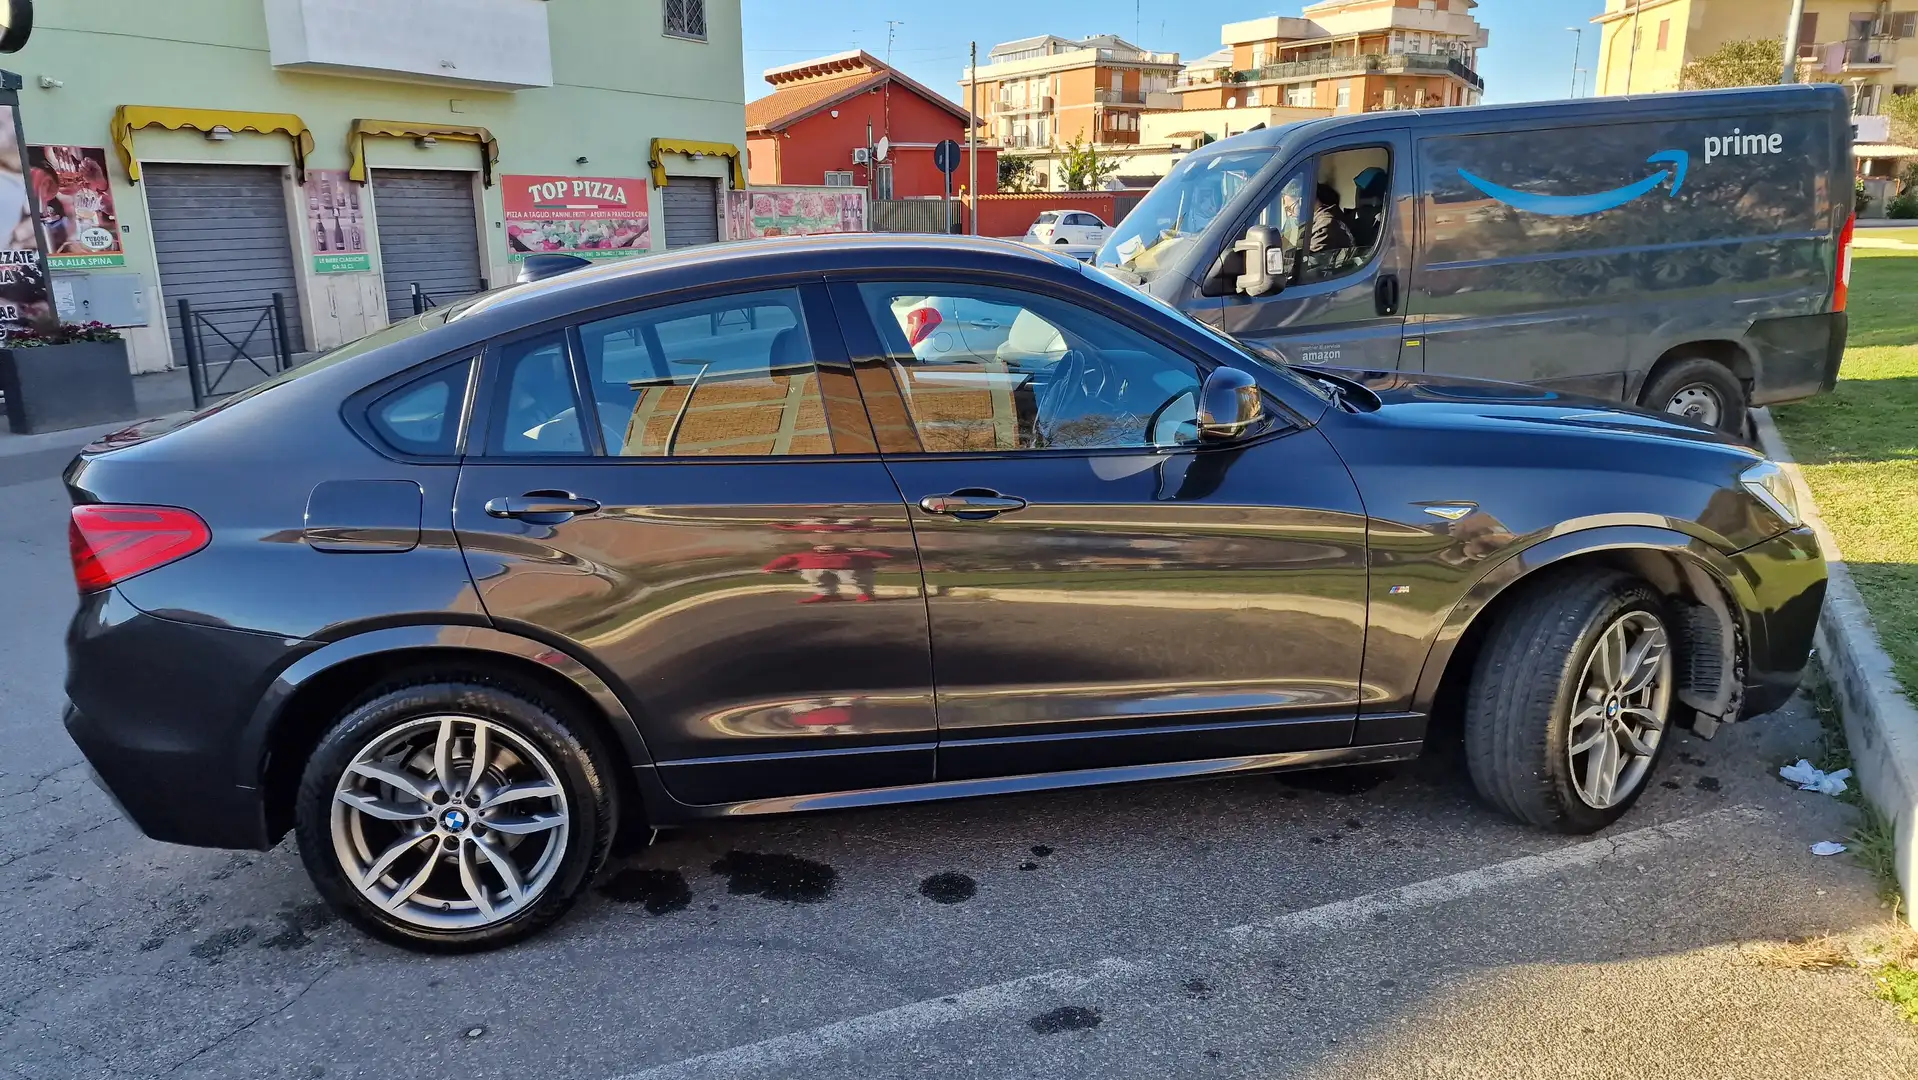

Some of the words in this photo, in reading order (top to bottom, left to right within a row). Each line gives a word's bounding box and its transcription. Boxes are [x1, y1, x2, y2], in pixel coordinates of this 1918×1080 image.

[1704, 127, 1783, 164] prime
[528, 181, 568, 203] TOP
[571, 180, 627, 204] PIZZA
[88, 257, 113, 265] SPINA
[1302, 350, 1341, 361] amazon
